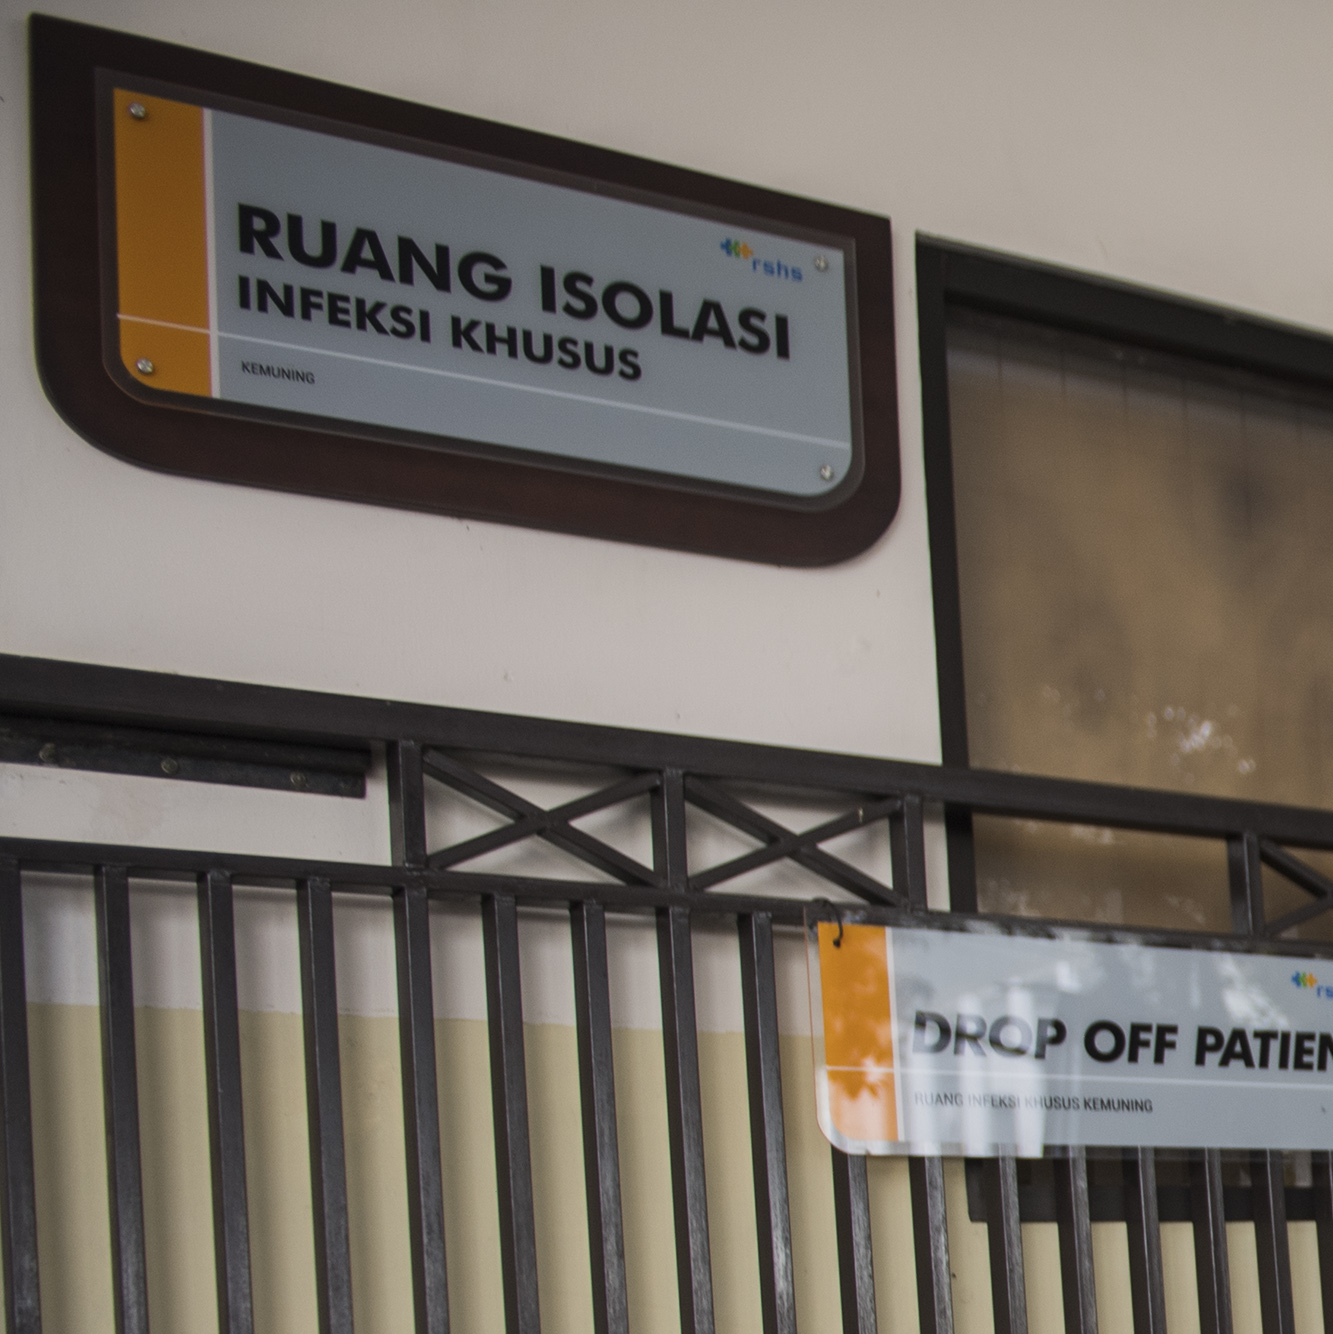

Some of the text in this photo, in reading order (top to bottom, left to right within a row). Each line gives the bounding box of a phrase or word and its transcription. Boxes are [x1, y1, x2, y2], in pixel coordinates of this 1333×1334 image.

[238, 203, 790, 361] RUANG ISOLASI
[752, 257, 803, 281] rshs
[238, 274, 642, 381] INFEKSI KHUSUS
[241, 360, 316, 384] KEMUNING
[912, 1010, 1067, 1060] DROP
[1083, 1019, 1178, 1064] OFF
[914, 1092, 1153, 1113] RUANG INFEKSI KHUSUS KEMUNING
